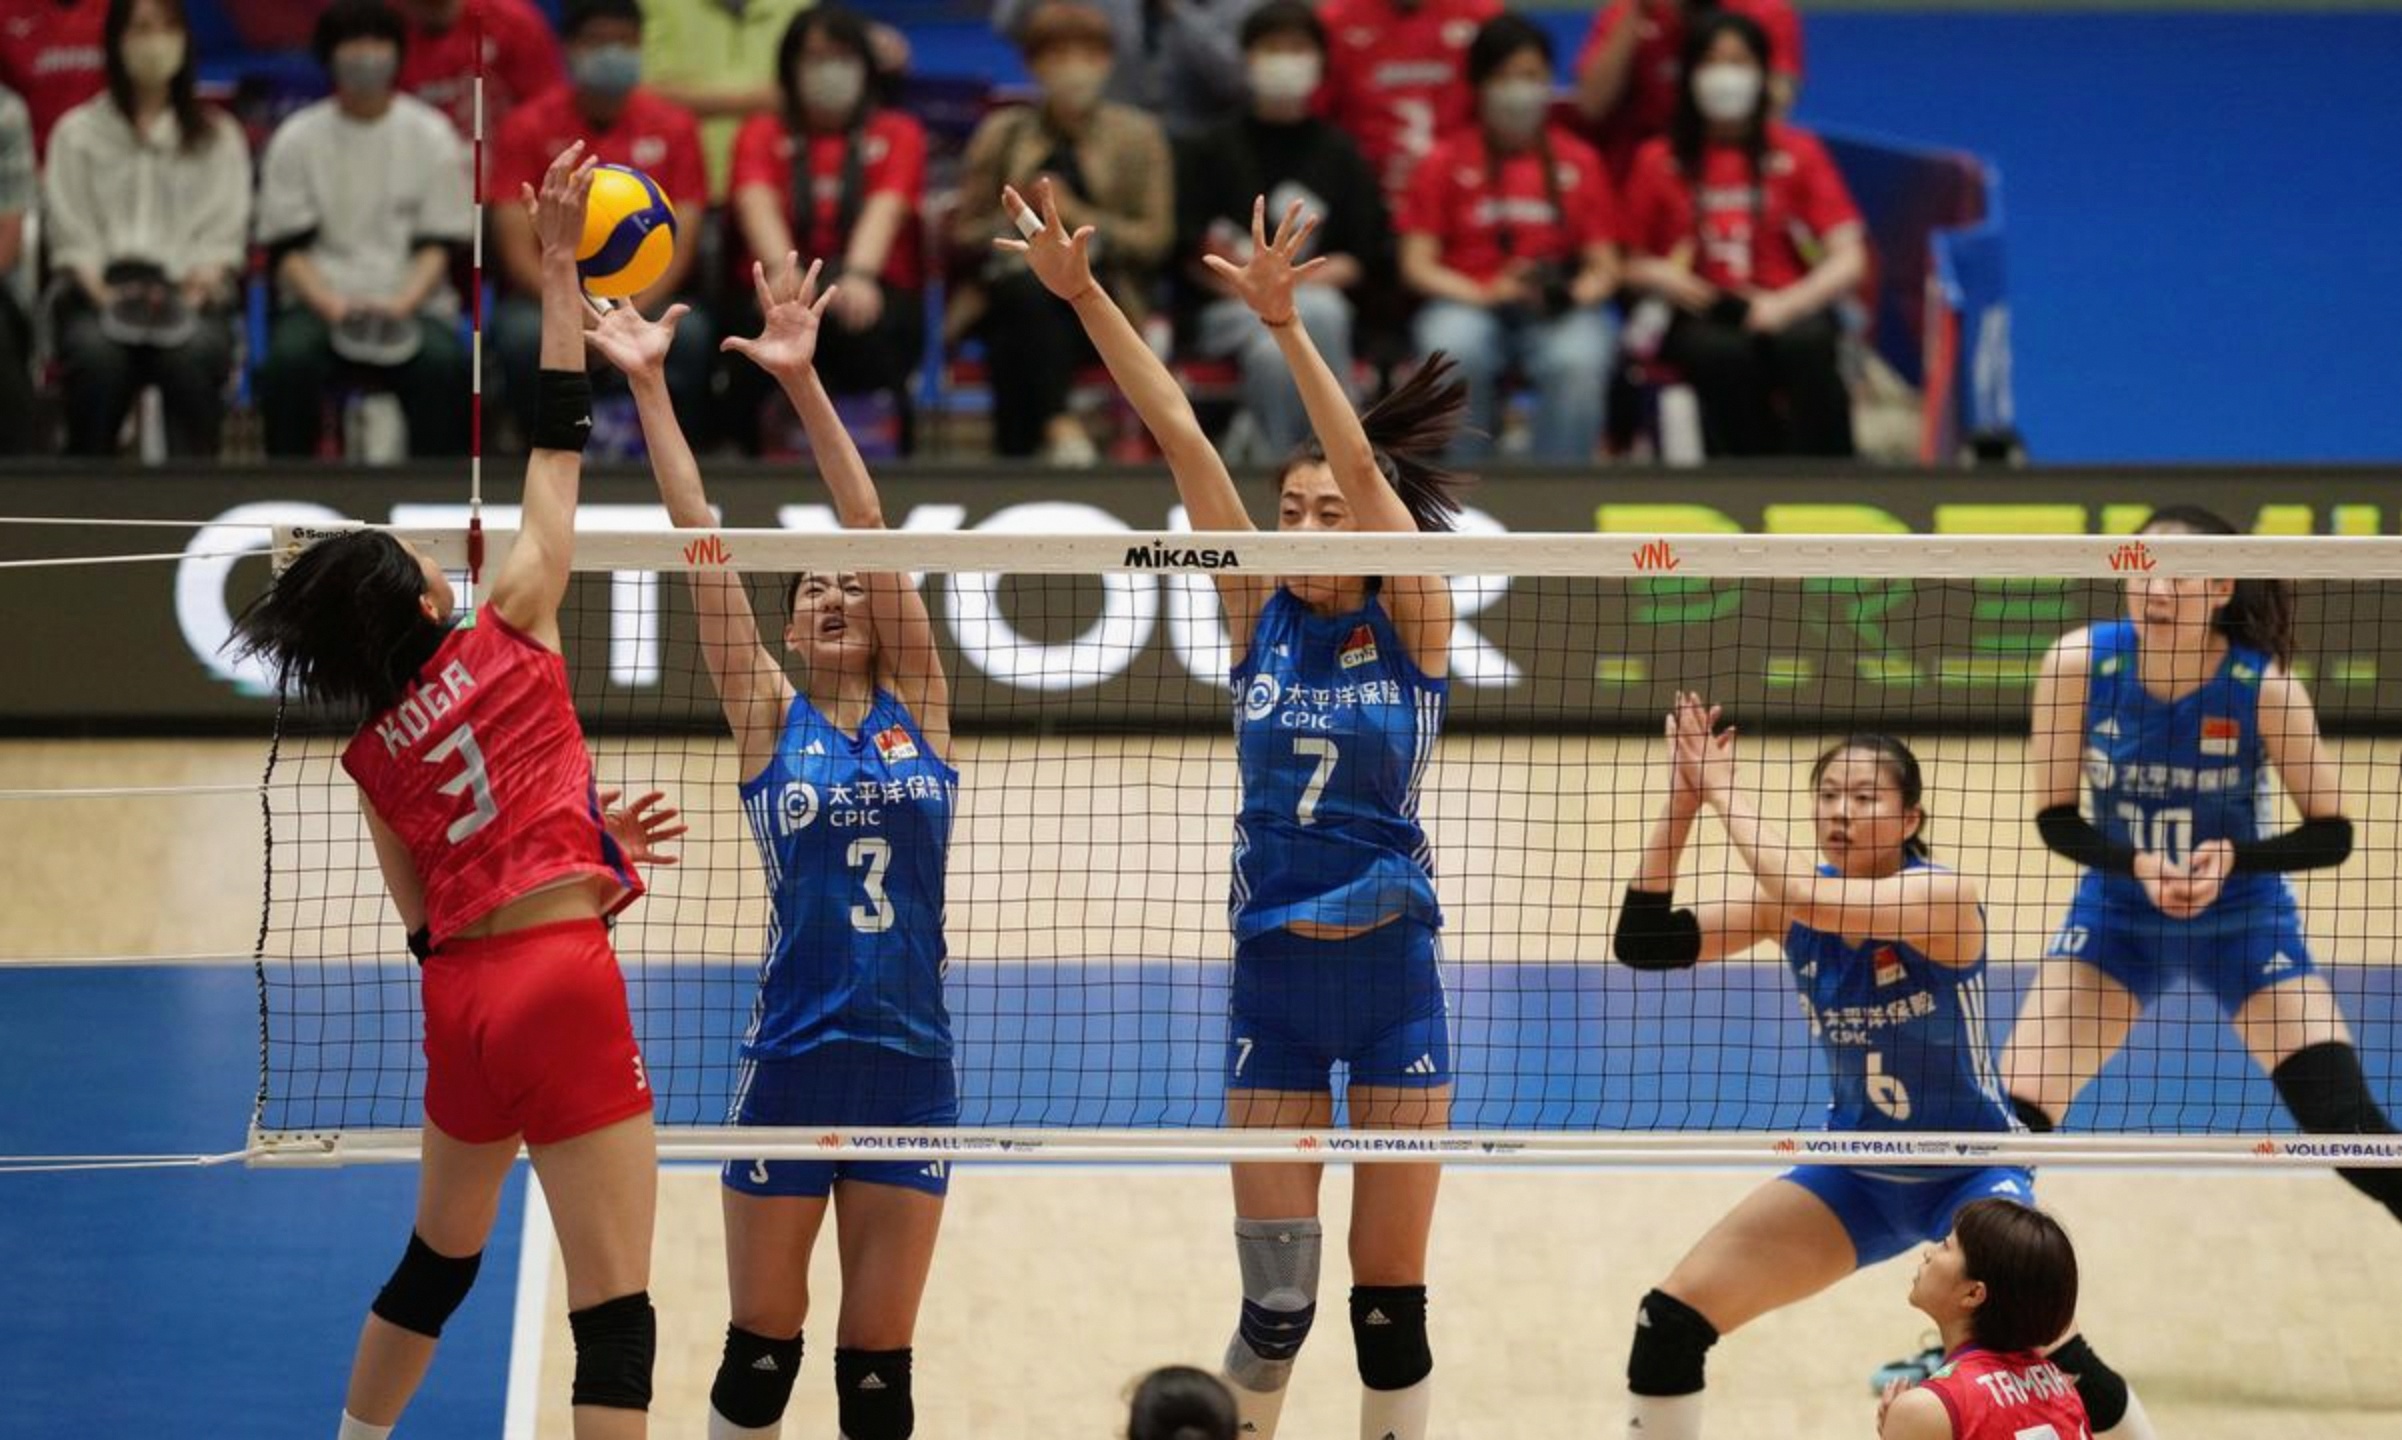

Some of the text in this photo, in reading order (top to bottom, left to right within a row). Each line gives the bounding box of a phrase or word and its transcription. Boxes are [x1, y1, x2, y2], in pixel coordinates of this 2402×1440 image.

[683, 534, 732, 565] VNL
[1632, 538, 1680, 570] VNL
[2109, 540, 2157, 571] VNL
[375, 659, 477, 758] KOGA
[1281, 711, 1333, 729] CPIC
[422, 722, 499, 845] 3
[1293, 737, 1340, 828] 7
[829, 809, 882, 827] CPIC
[846, 837, 896, 933] 3
[1235, 1037, 1253, 1077] 7
[1866, 1051, 1912, 1121] 6
[852, 1136, 959, 1149] VOLLEYBALL
[1329, 1138, 1435, 1151] VOLLEYBALL
[1806, 1141, 1914, 1154] VOLLEYBALL
[2285, 1143, 2393, 1157] VOLLEYBALL
